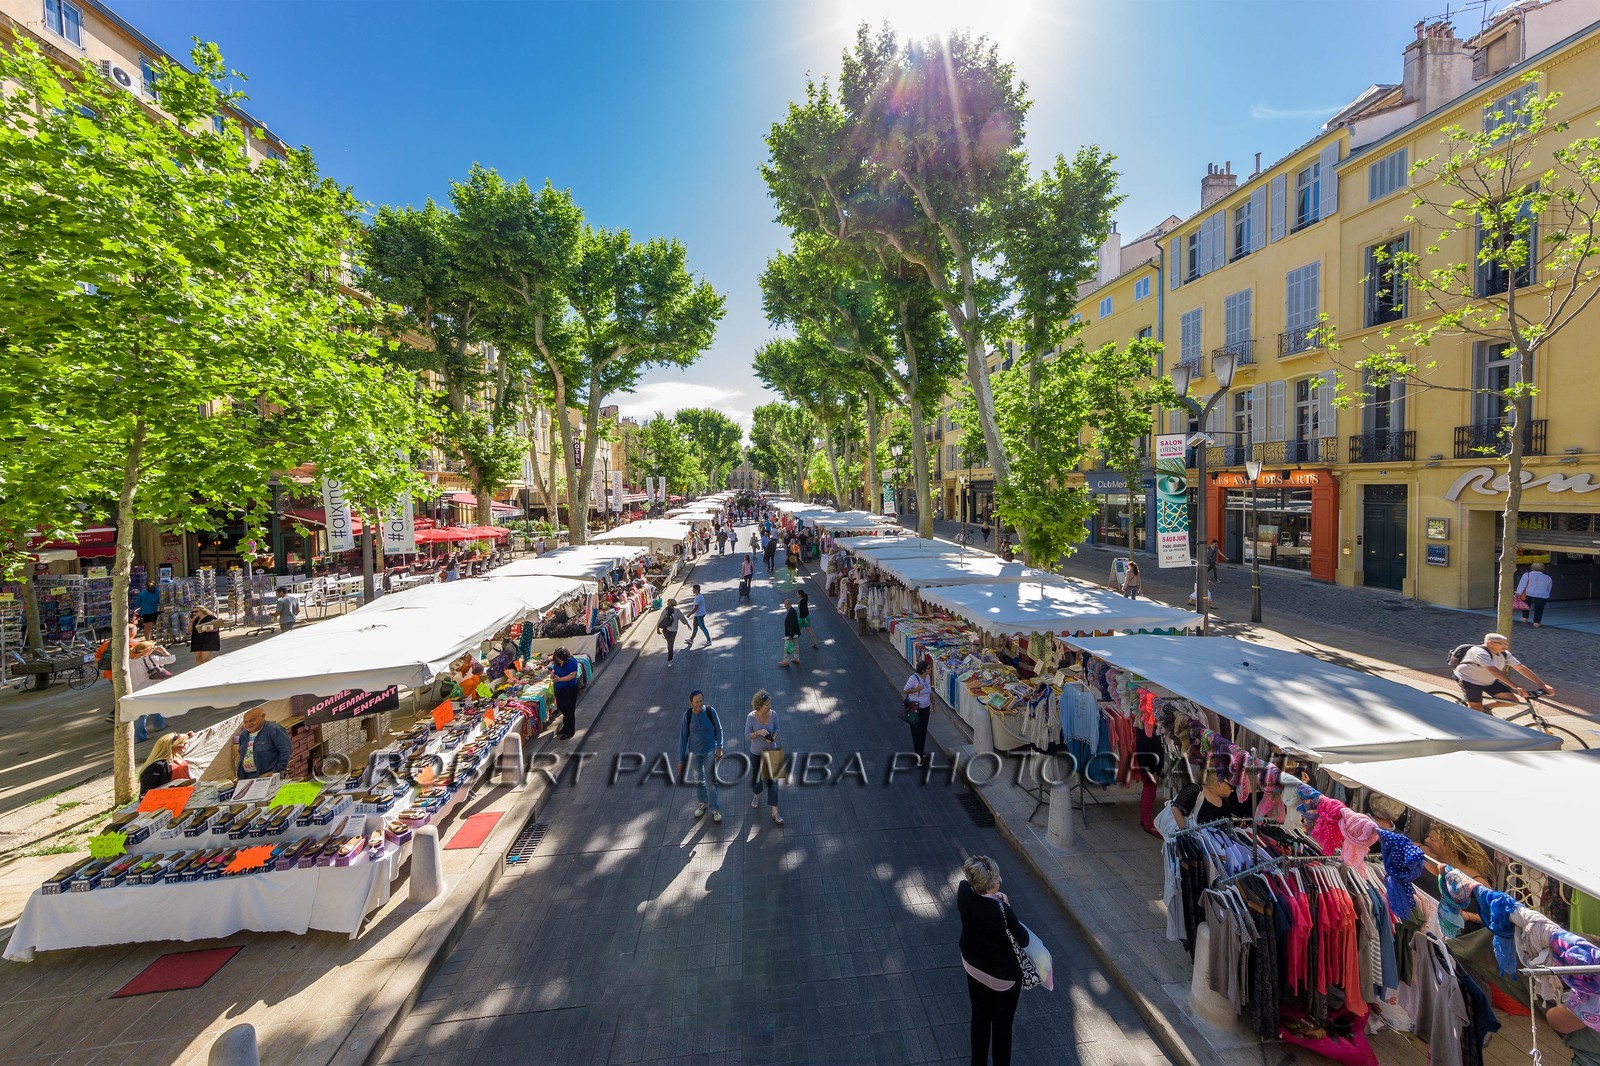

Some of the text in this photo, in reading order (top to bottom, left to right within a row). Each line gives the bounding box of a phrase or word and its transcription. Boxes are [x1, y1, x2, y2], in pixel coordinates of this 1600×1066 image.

[1212, 476, 1229, 485] LES
[1262, 475, 1283, 485] DES
[1287, 474, 1319, 485] ARTS
[307, 689, 351, 716] HOMME
[332, 691, 372, 716] FEMME
[353, 686, 397, 716] ENFANT
